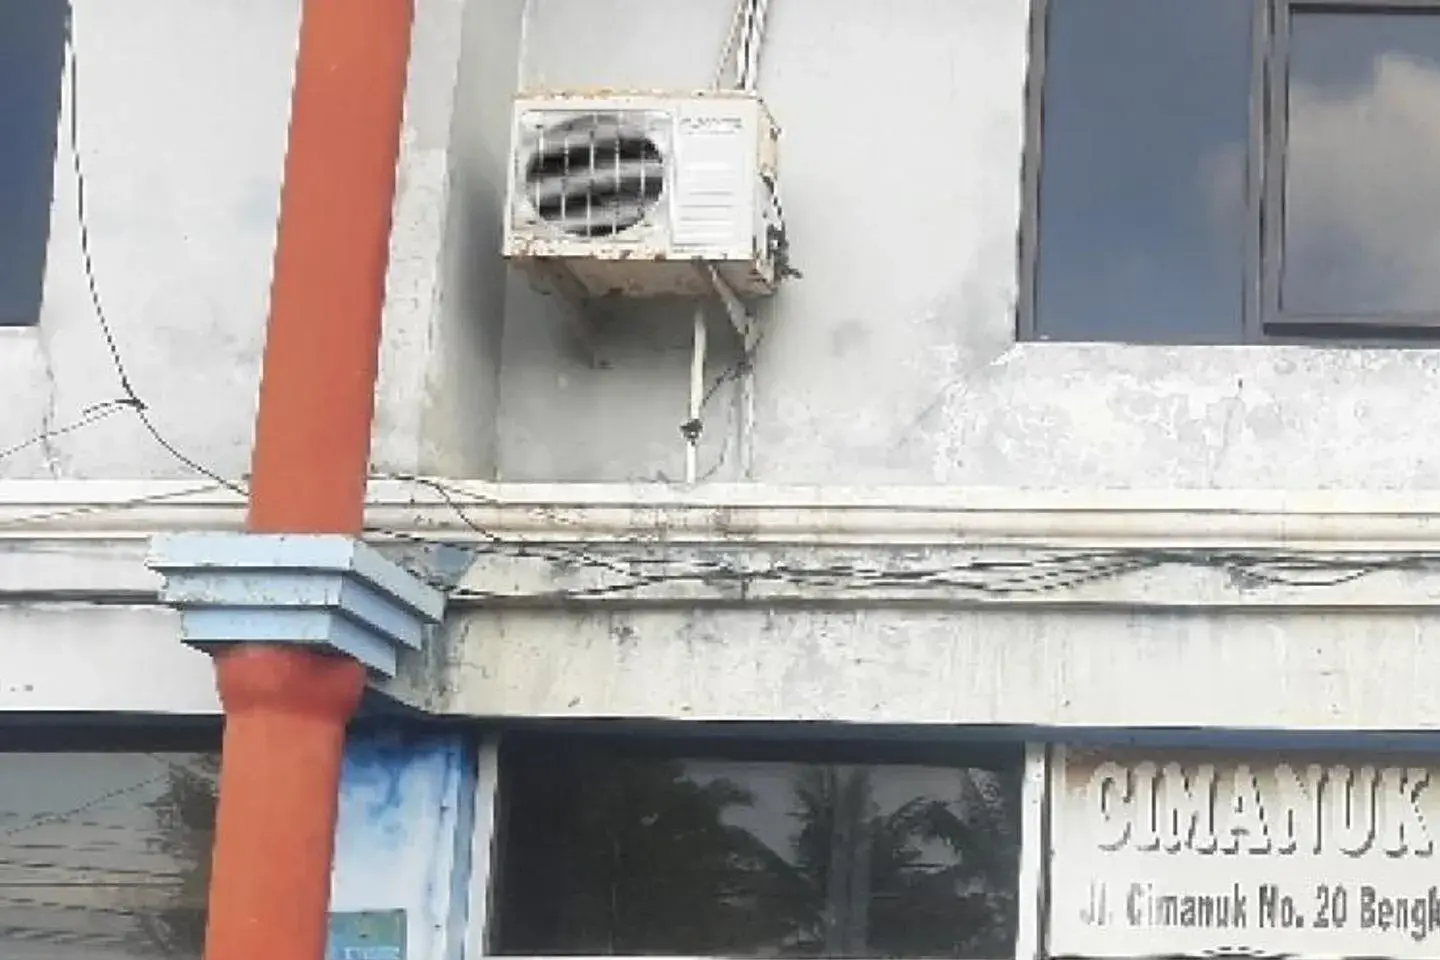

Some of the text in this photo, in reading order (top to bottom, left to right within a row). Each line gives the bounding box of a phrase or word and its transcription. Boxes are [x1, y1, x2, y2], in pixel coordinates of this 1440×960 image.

[1088, 761, 1432, 857] CIMANUK
[1126, 883, 1247, 928] Cimanuk
[1258, 885, 1304, 928] No.
[1313, 885, 1348, 928] 20
